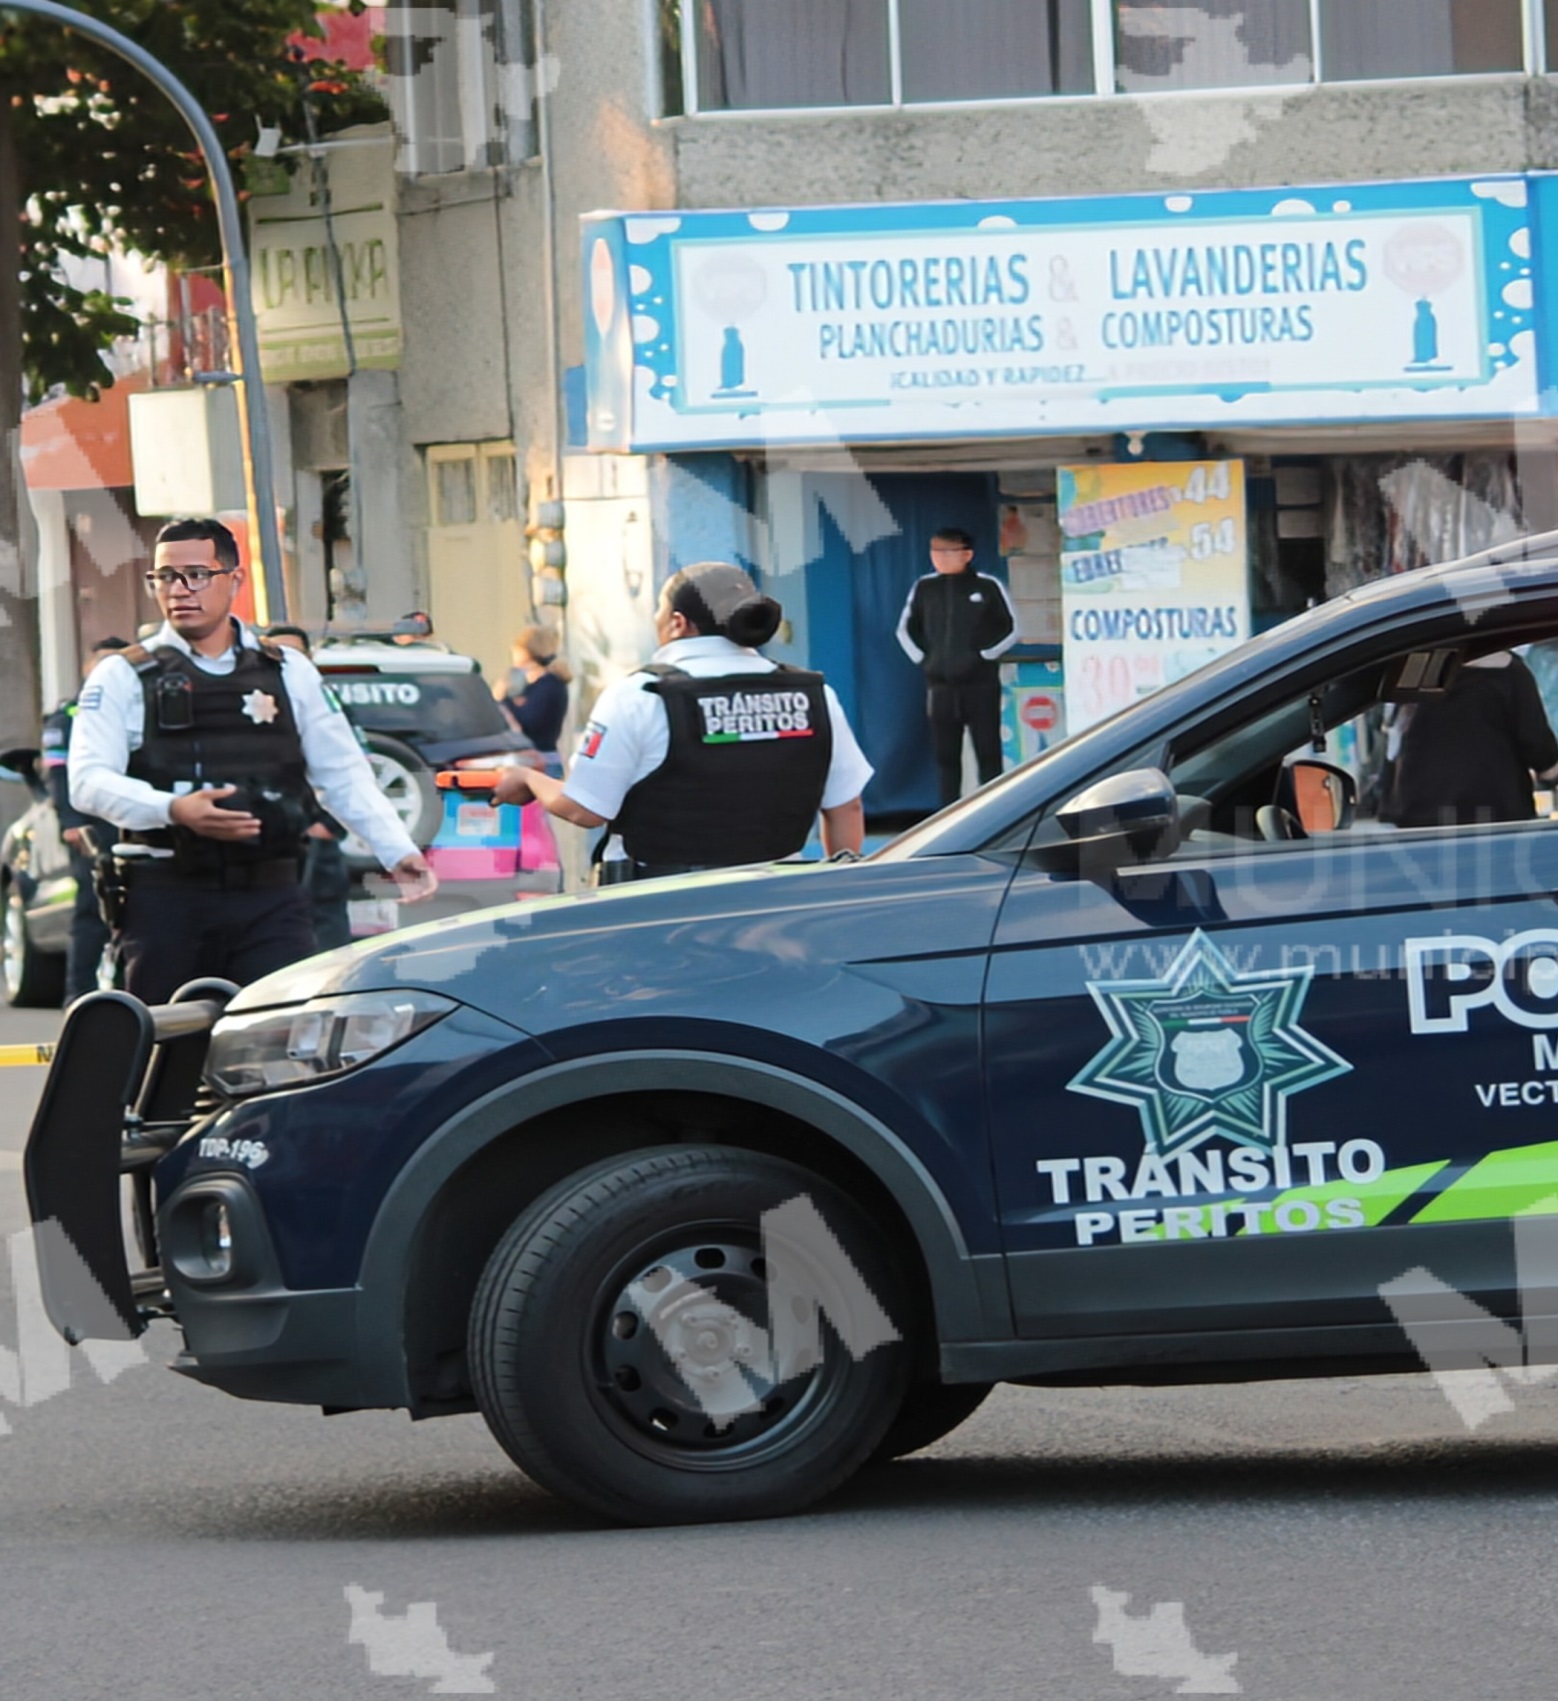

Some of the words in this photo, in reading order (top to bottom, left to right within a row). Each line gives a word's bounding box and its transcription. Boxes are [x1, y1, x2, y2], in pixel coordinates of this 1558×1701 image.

[787, 253, 1030, 313] TINTORERIAS
[1110, 239, 1369, 300] LAVANDERIAS
[819, 314, 1045, 359] PLANCHADURIAS
[1101, 304, 1315, 349] COMPOSTURAS
[1070, 606, 1237, 641] COMPOSTURAS
[698, 692, 809, 718] TRÁNSITO
[706, 711, 809, 734] PERITOS
[1036, 1139, 1386, 1204] TRÁNSITO
[1075, 1198, 1366, 1246] PERITOS
